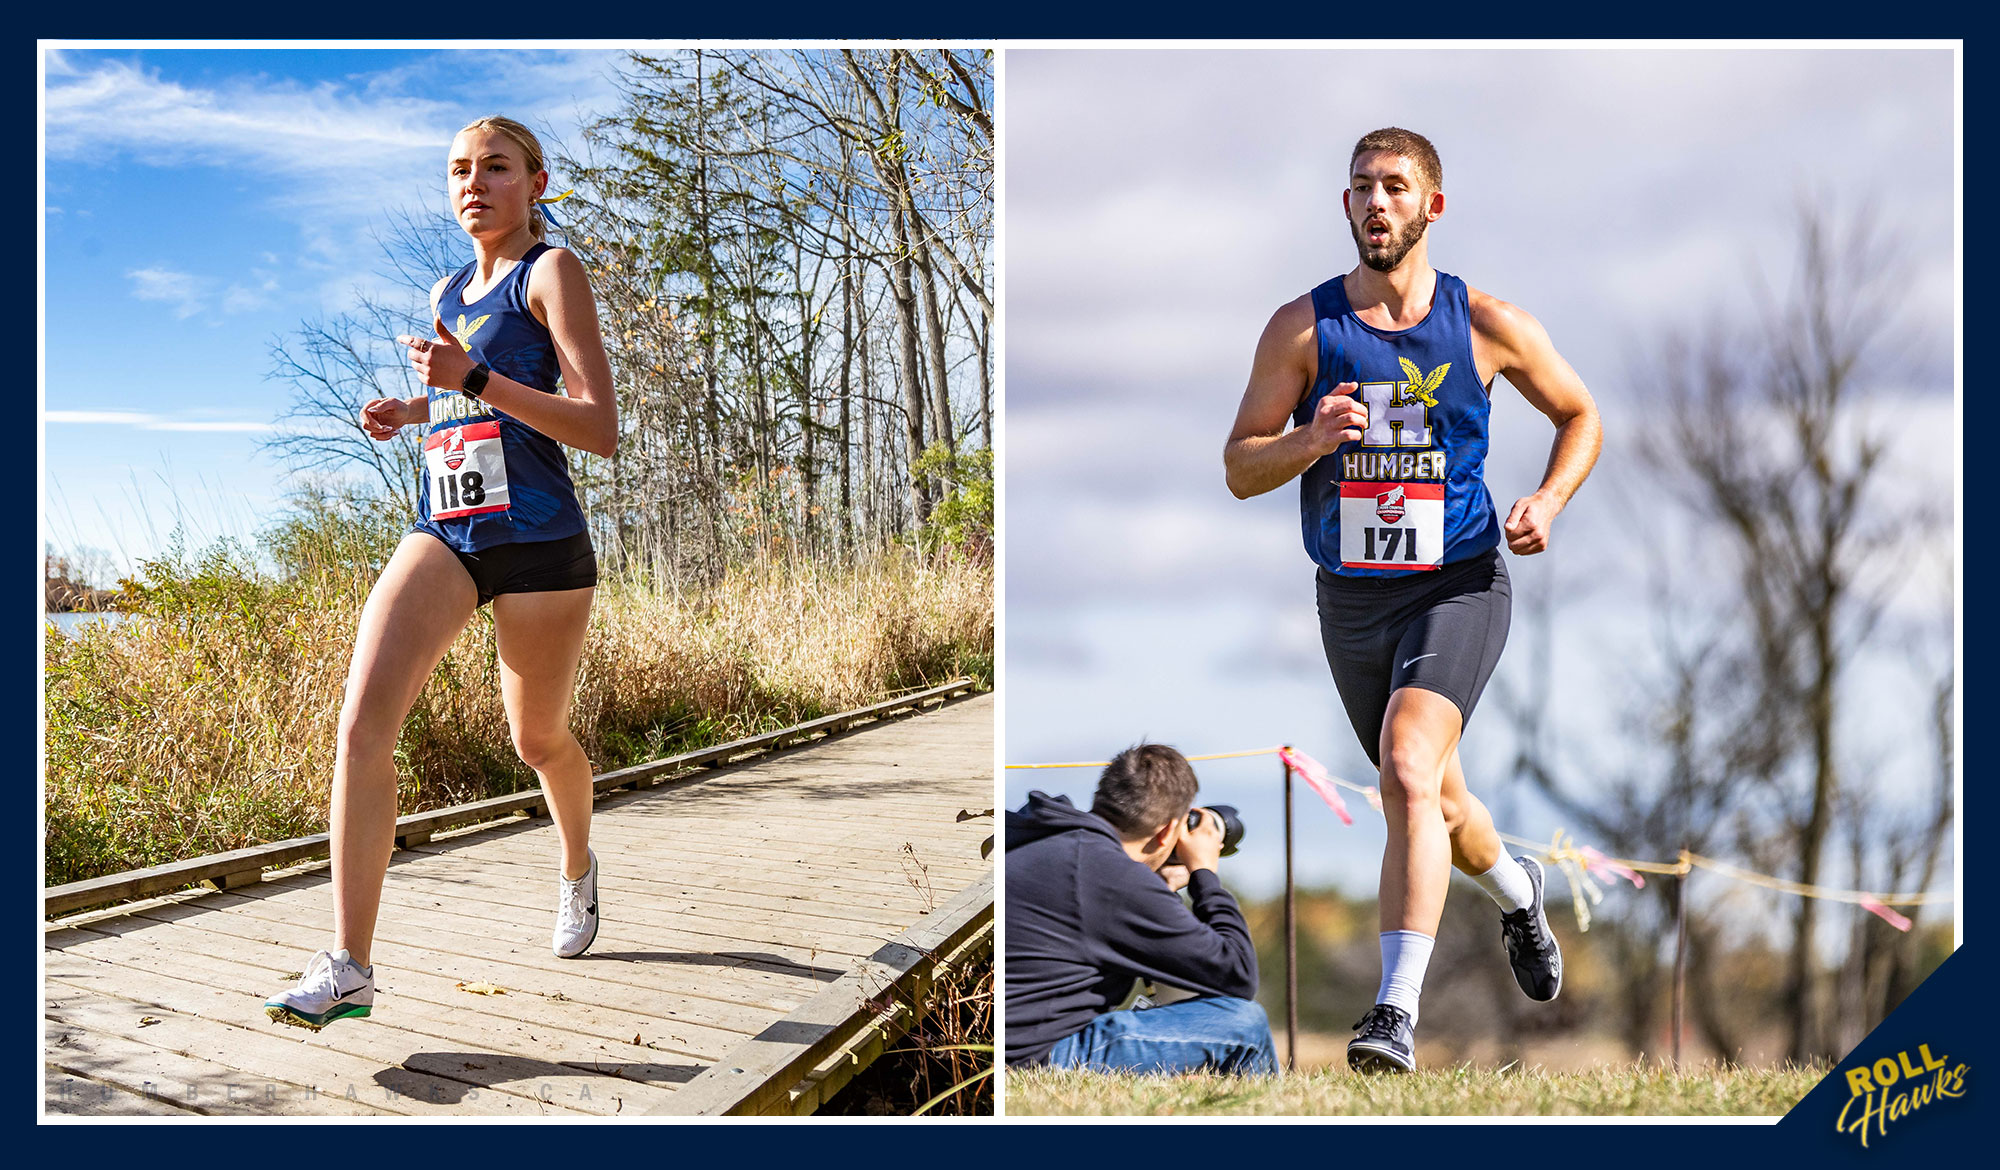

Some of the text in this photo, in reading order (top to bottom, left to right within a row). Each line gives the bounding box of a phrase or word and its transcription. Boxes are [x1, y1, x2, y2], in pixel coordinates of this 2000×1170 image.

[1343, 451, 1447, 480] HUMBER
[438, 471, 486, 510] 118
[1364, 527, 1418, 561] 171
